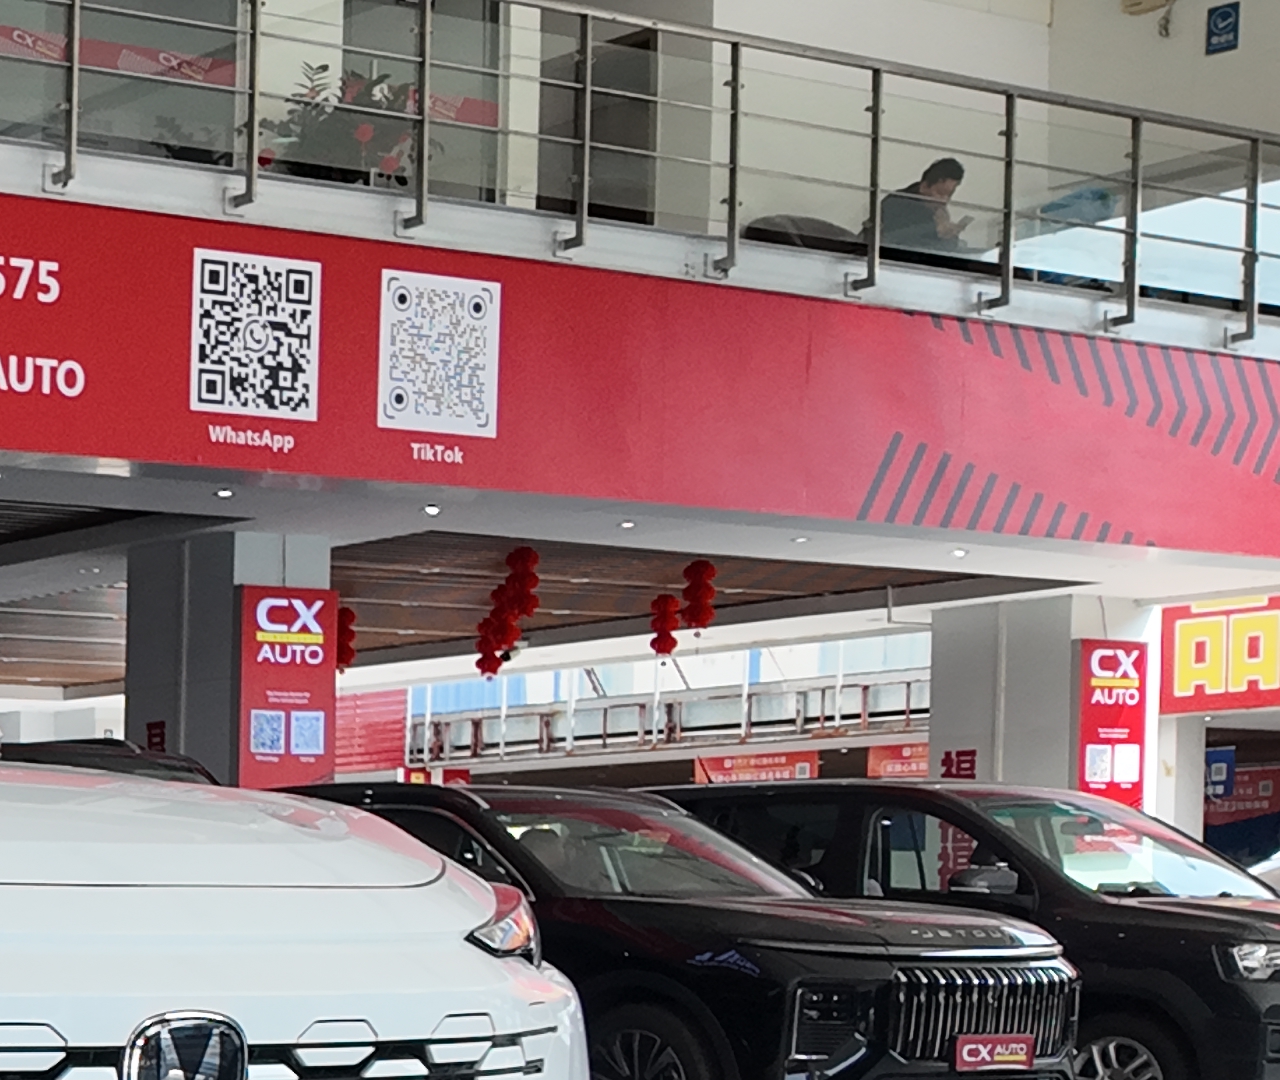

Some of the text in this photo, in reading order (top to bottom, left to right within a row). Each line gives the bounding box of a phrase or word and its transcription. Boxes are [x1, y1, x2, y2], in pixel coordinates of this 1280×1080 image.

[208, 424, 295, 452] WhatsApp
[410, 442, 464, 464] TikTok
[255, 596, 326, 634] CX
[256, 643, 325, 666] AUTO
[1090, 648, 1141, 679] CX
[1090, 688, 1140, 706] AUTO
[922, 929, 1008, 940] JETOU
[961, 1042, 1027, 1062] CX AUTO
